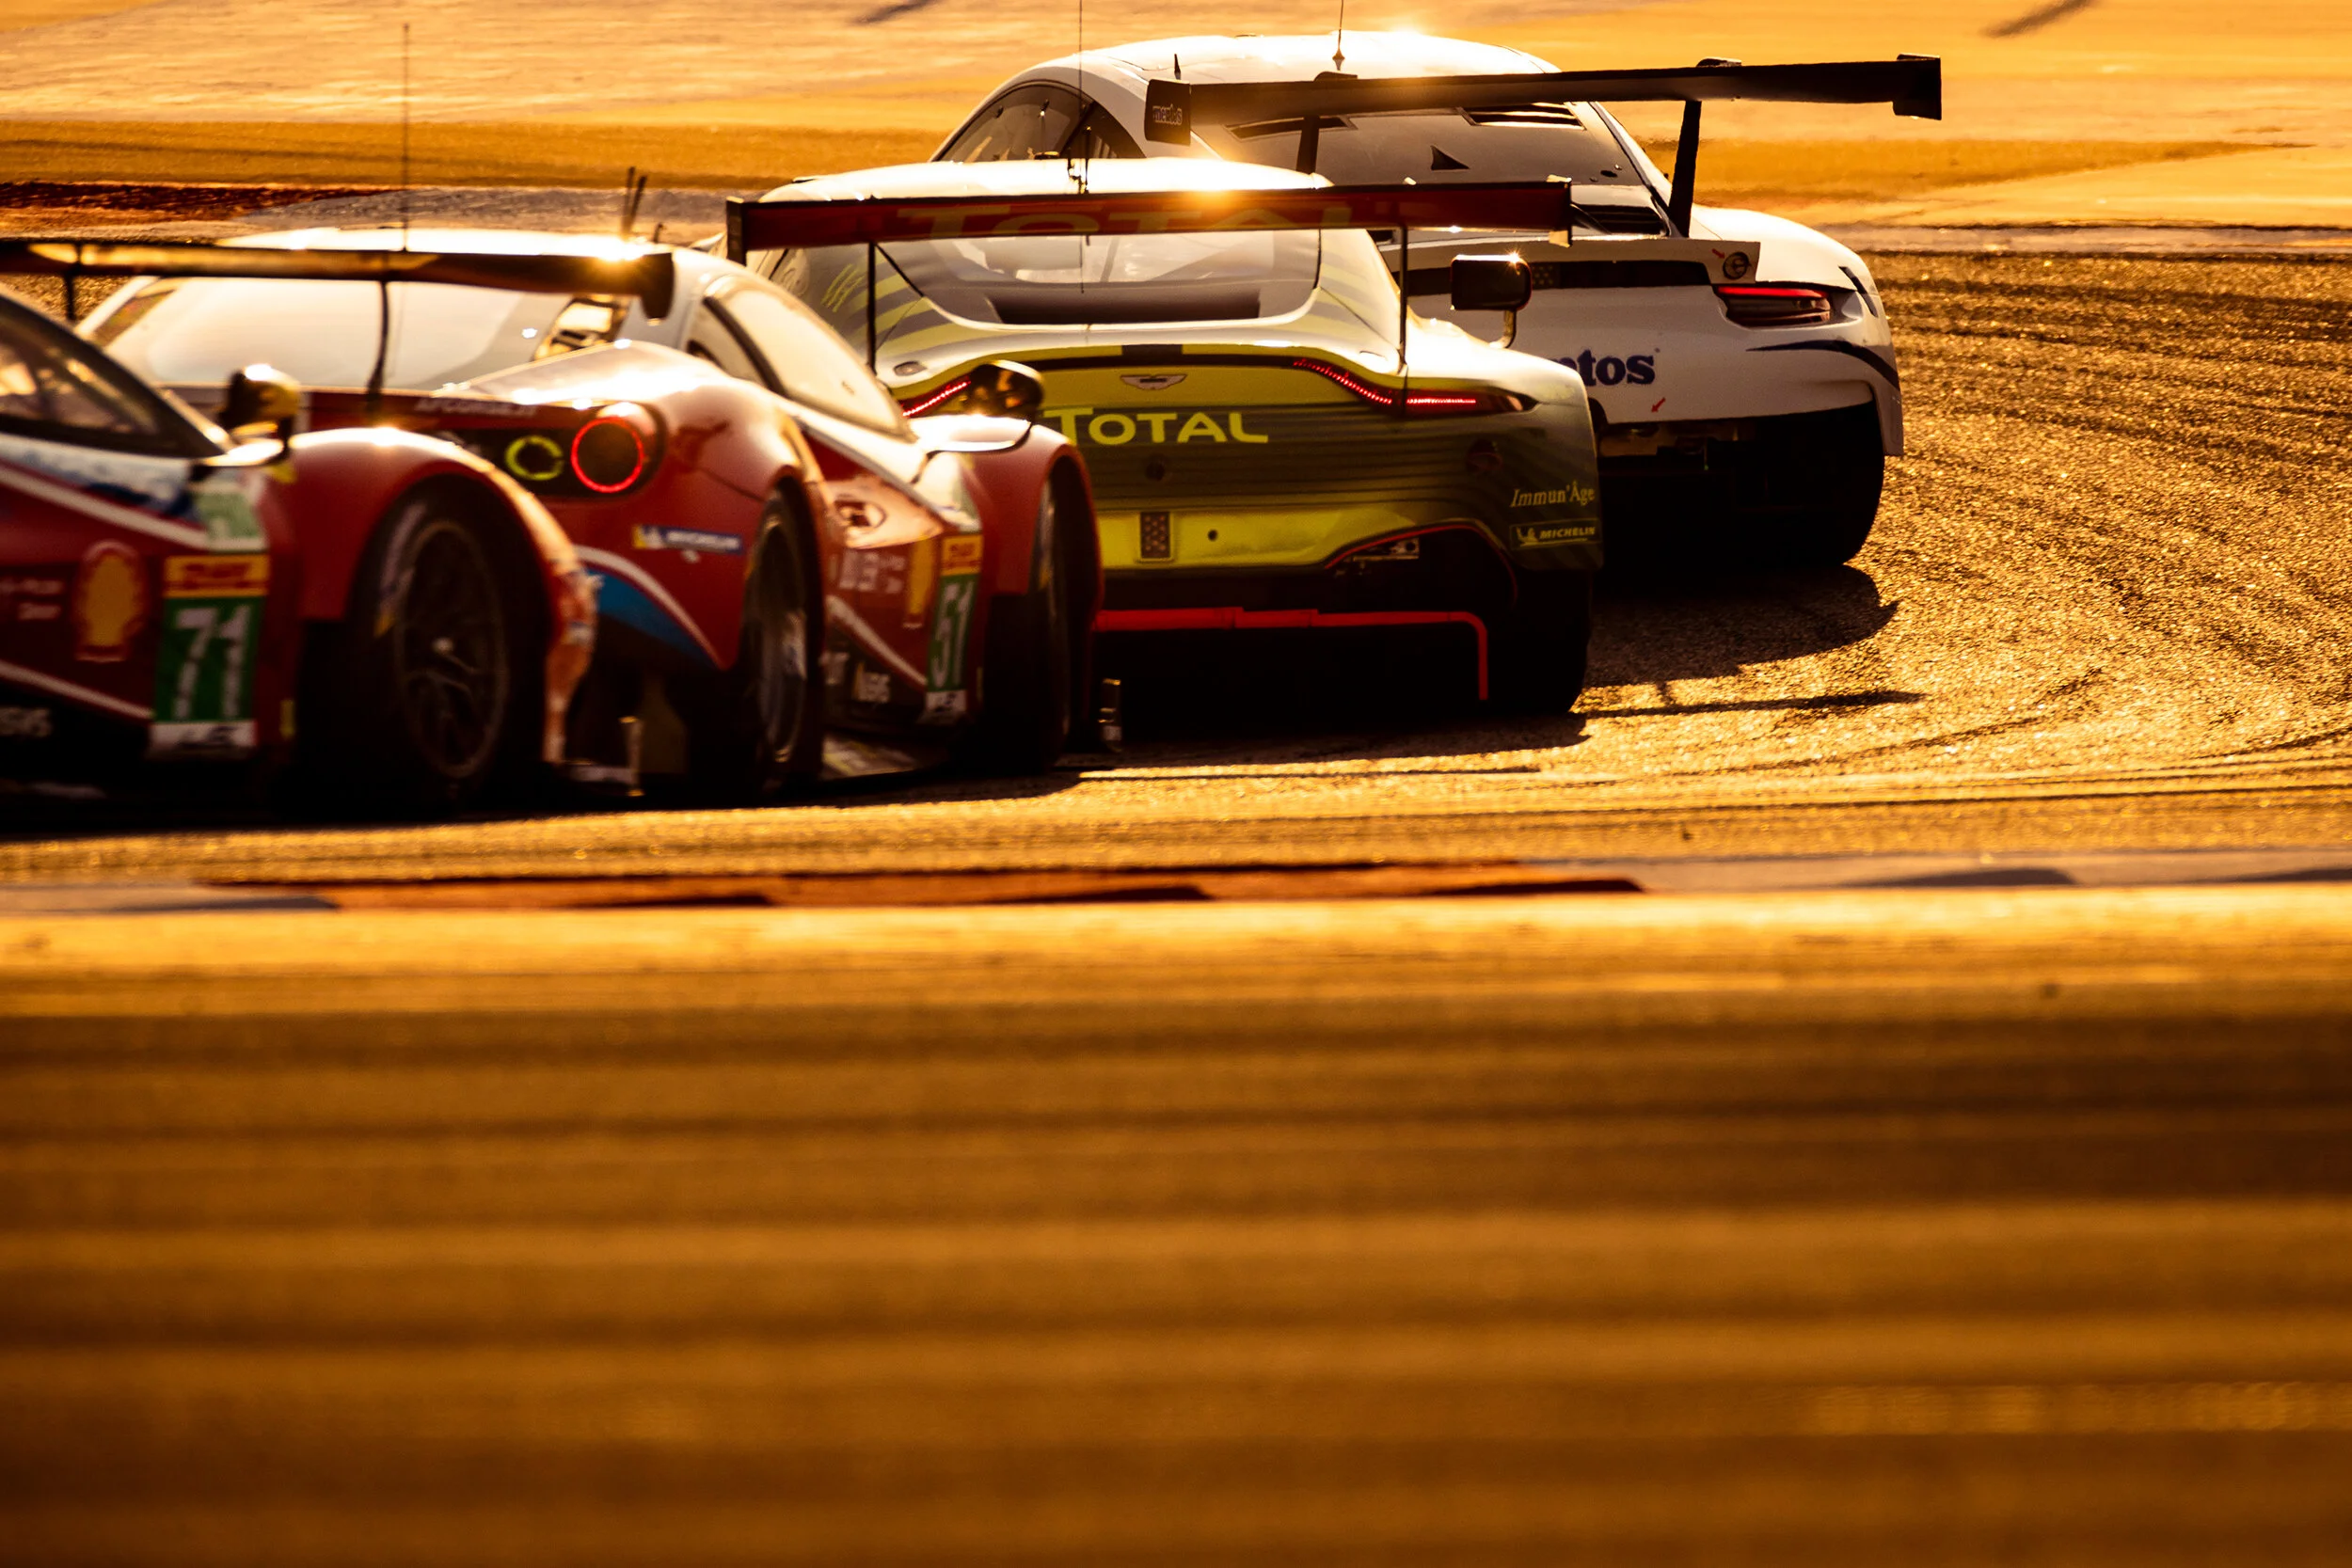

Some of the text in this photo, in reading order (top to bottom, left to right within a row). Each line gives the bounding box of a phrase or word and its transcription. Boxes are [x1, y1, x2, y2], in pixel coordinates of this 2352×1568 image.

[1043, 406, 1269, 446] TOTAL
[1539, 526, 1596, 540] MICHELIN
[171, 603, 252, 721] 71
[931, 579, 975, 689] 51
